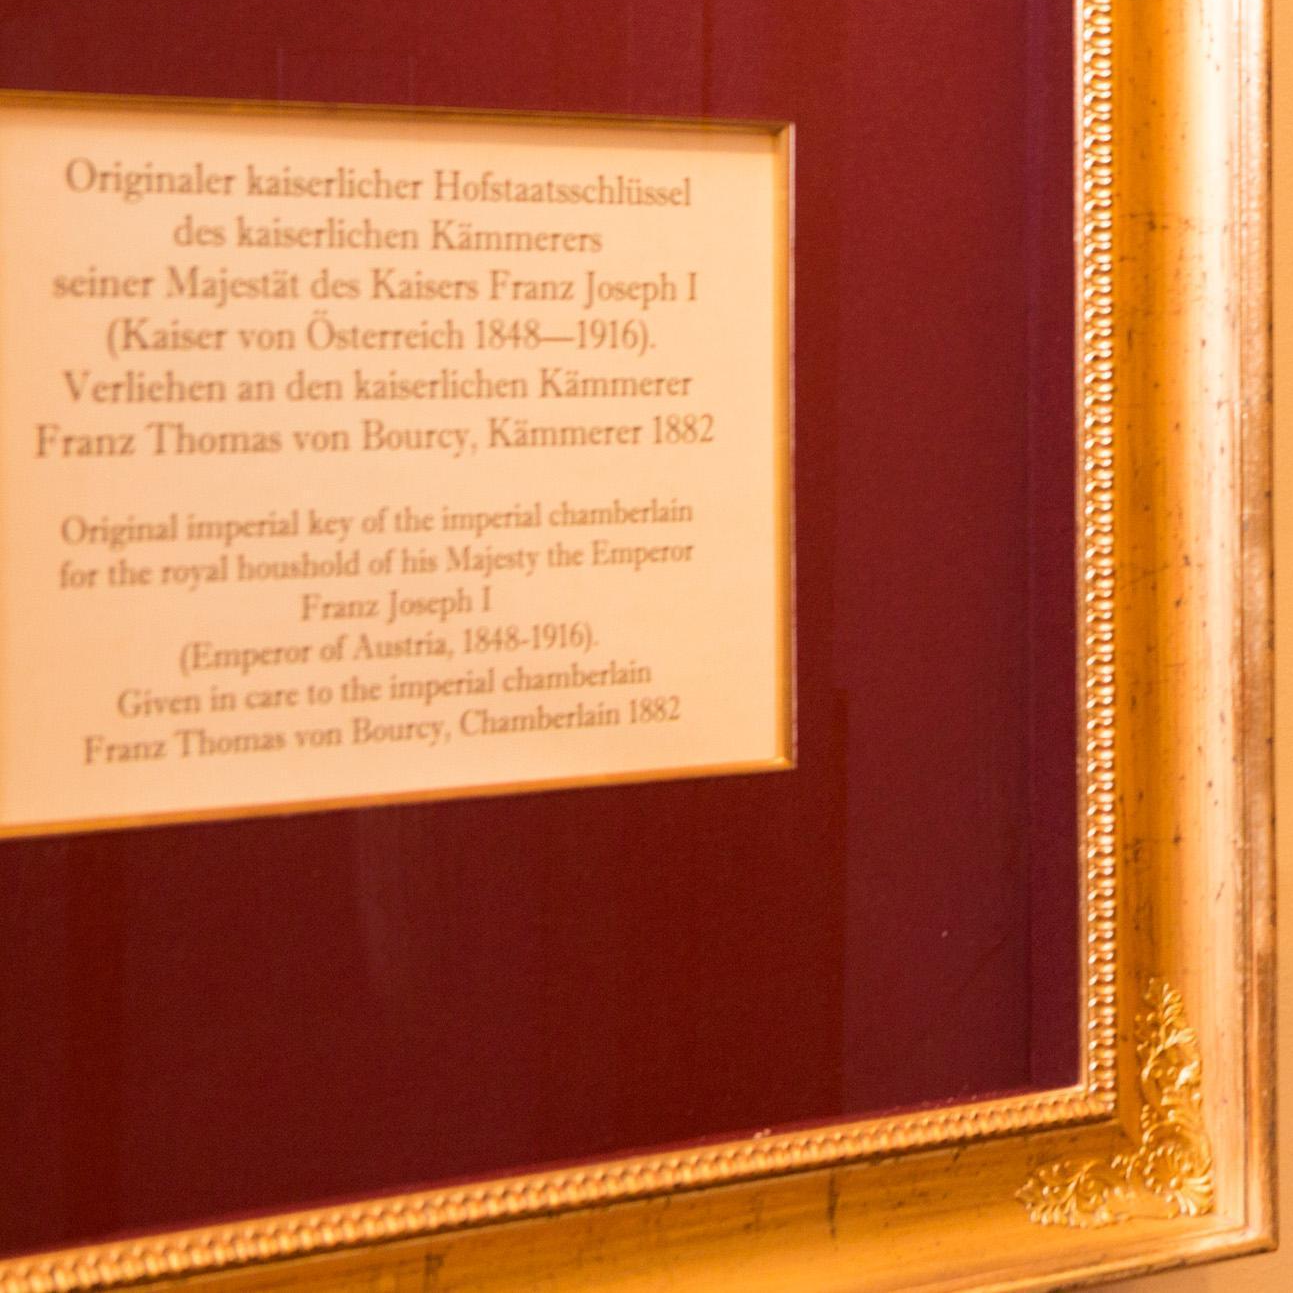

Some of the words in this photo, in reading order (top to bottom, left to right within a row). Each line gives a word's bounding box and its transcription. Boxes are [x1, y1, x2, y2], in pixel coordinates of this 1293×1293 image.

[65, 158, 237, 200] Originaler
[245, 165, 424, 199] kaiserlicher
[433, 169, 692, 206] Hofstaatsschlüssel
[172, 214, 226, 247] des
[234, 216, 419, 249] kaiserlichen
[430, 219, 603, 252] Kämmerers
[51, 267, 156, 298] seiner
[165, 265, 300, 307] Majestät
[309, 267, 361, 299] des
[369, 267, 480, 300] Kaisers
[488, 268, 574, 301] Franz
[584, 270, 678, 310] Joseph
[686, 271, 697, 302] I
[106, 316, 228, 356] (Kaiser
[237, 328, 296, 350] von
[305, 310, 465, 350] Österreich
[61, 369, 227, 403] Verliehen
[236, 380, 275, 402] an
[284, 369, 344, 401] den
[352, 368, 529, 400] kaiserlichen
[538, 367, 694, 398] Kämmerer
[34, 423, 136, 458] Franz
[144, 421, 283, 455] Thomas
[292, 430, 351, 452] von
[360, 418, 478, 457] Bourcy,
[487, 417, 643, 448] Kämmerer
[652, 413, 715, 444] 1882
[59, 514, 179, 549] Original
[186, 510, 300, 546] imperial
[307, 509, 354, 542] key
[360, 506, 390, 534] of
[393, 506, 435, 533] the
[441, 502, 543, 537] imperial
[547, 498, 694, 526] chamberlain
[58, 560, 100, 589] for
[106, 558, 153, 587] the
[159, 554, 229, 591] royal
[235, 550, 361, 581] houshold
[367, 547, 396, 575] of
[400, 547, 439, 574] his
[445, 545, 540, 577] Majesty
[546, 541, 585, 567] the
[591, 539, 695, 571] Emperor
[299, 593, 380, 621] Franz
[386, 587, 473, 624] Joseph
[481, 584, 492, 612] I
[177, 641, 314, 675] (Emperor
[318, 633, 349, 662] of
[351, 631, 455, 659] Austria,
[115, 689, 202, 717] Given
[209, 686, 238, 712] in
[243, 688, 300, 709] care
[306, 684, 334, 705] to
[339, 675, 383, 703] the
[388, 668, 496, 705] imperial
[501, 660, 653, 692] chamberlain
[83, 735, 167, 764] Franz
[172, 728, 287, 757] Thomas
[293, 727, 343, 747] von
[350, 716, 451, 745] Bourcy,
[458, 703, 621, 735] Chamberlain
[628, 695, 681, 724] 1882
